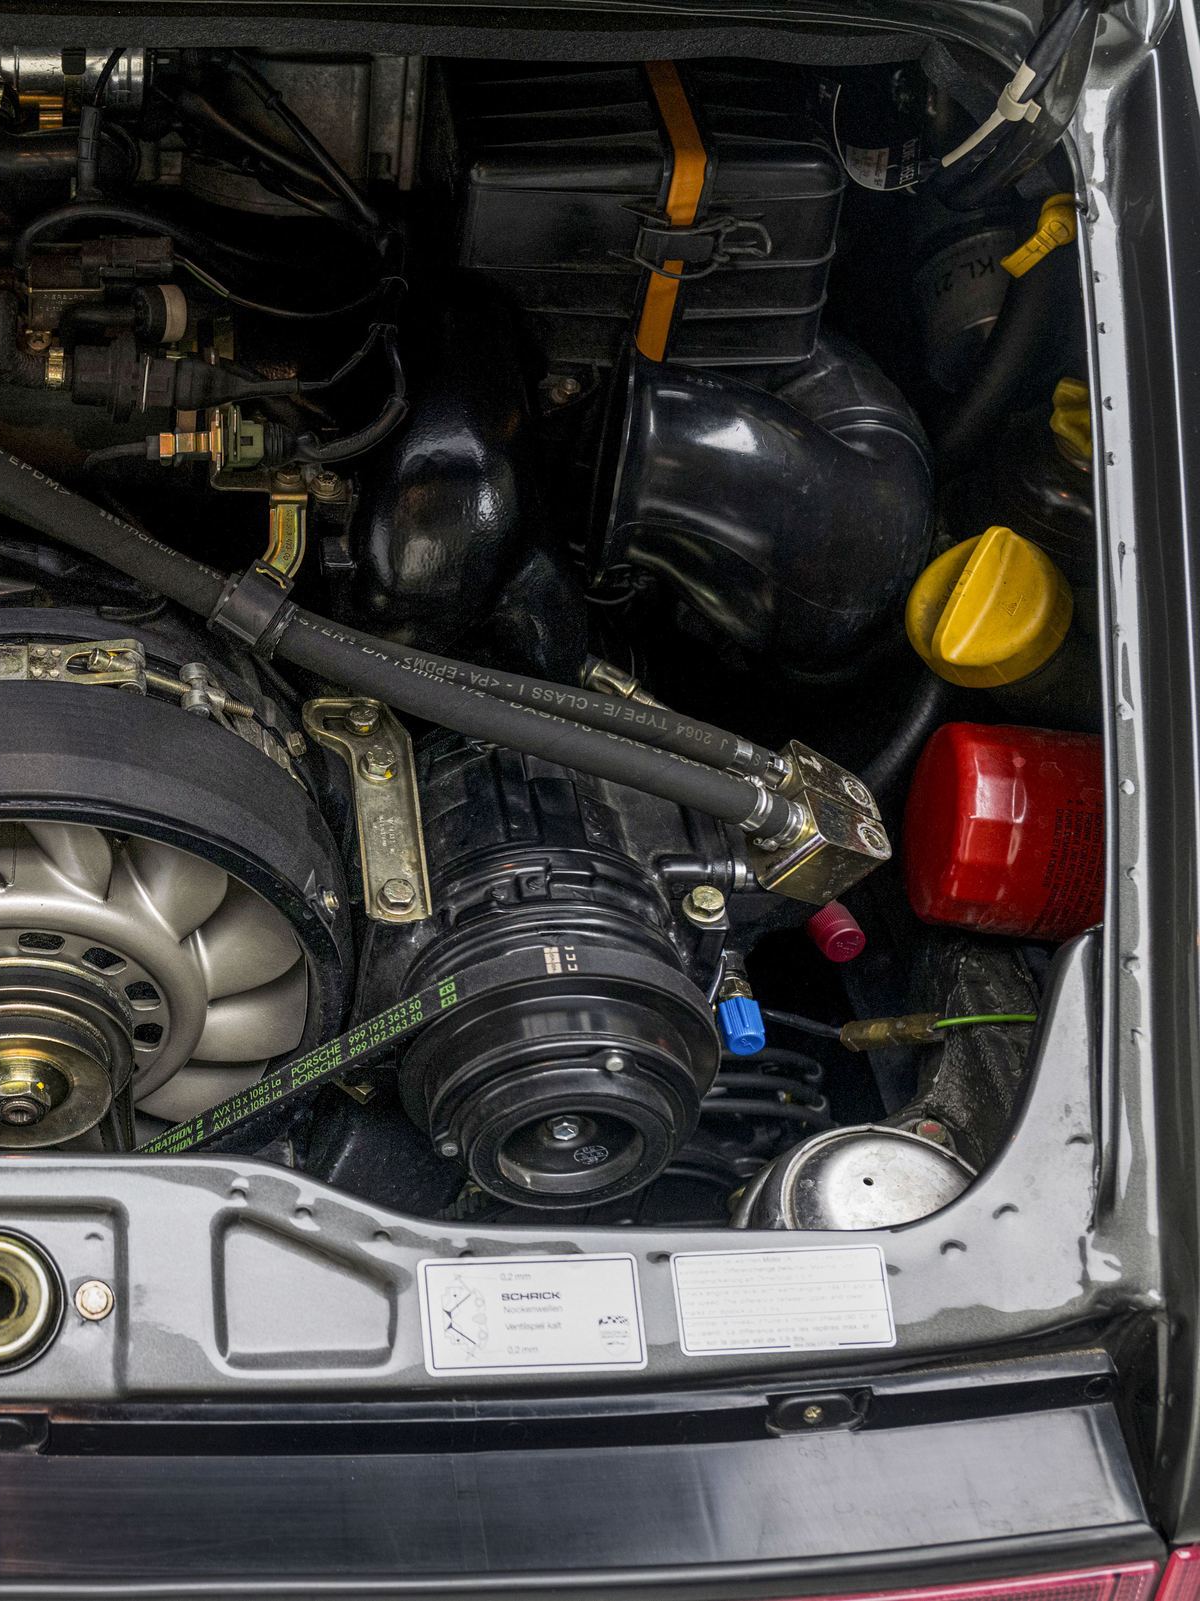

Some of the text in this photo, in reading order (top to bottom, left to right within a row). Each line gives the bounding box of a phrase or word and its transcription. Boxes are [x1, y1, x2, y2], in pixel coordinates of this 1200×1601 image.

[532, 687, 588, 710] CLASS
[675, 721, 712, 745] 2064
[196, 1119, 203, 1130] 2
[212, 1104, 231, 1120] AVX
[232, 1100, 241, 1110] 13
[249, 1083, 269, 1100] 1085
[271, 1078, 281, 1089] La
[291, 1044, 341, 1078] PORSCHE
[349, 999, 422, 1045] 999.192.363.50
[196, 1130, 204, 1141] 2
[213, 1115, 232, 1132] AVX
[233, 1111, 241, 1120] 13
[250, 1094, 270, 1111] 1085
[272, 1089, 282, 1100] La
[292, 1055, 342, 1089] PORSCHE
[350, 1011, 423, 1057] 999.192.363.50
[501, 1291, 561, 1301] SCHRICK
